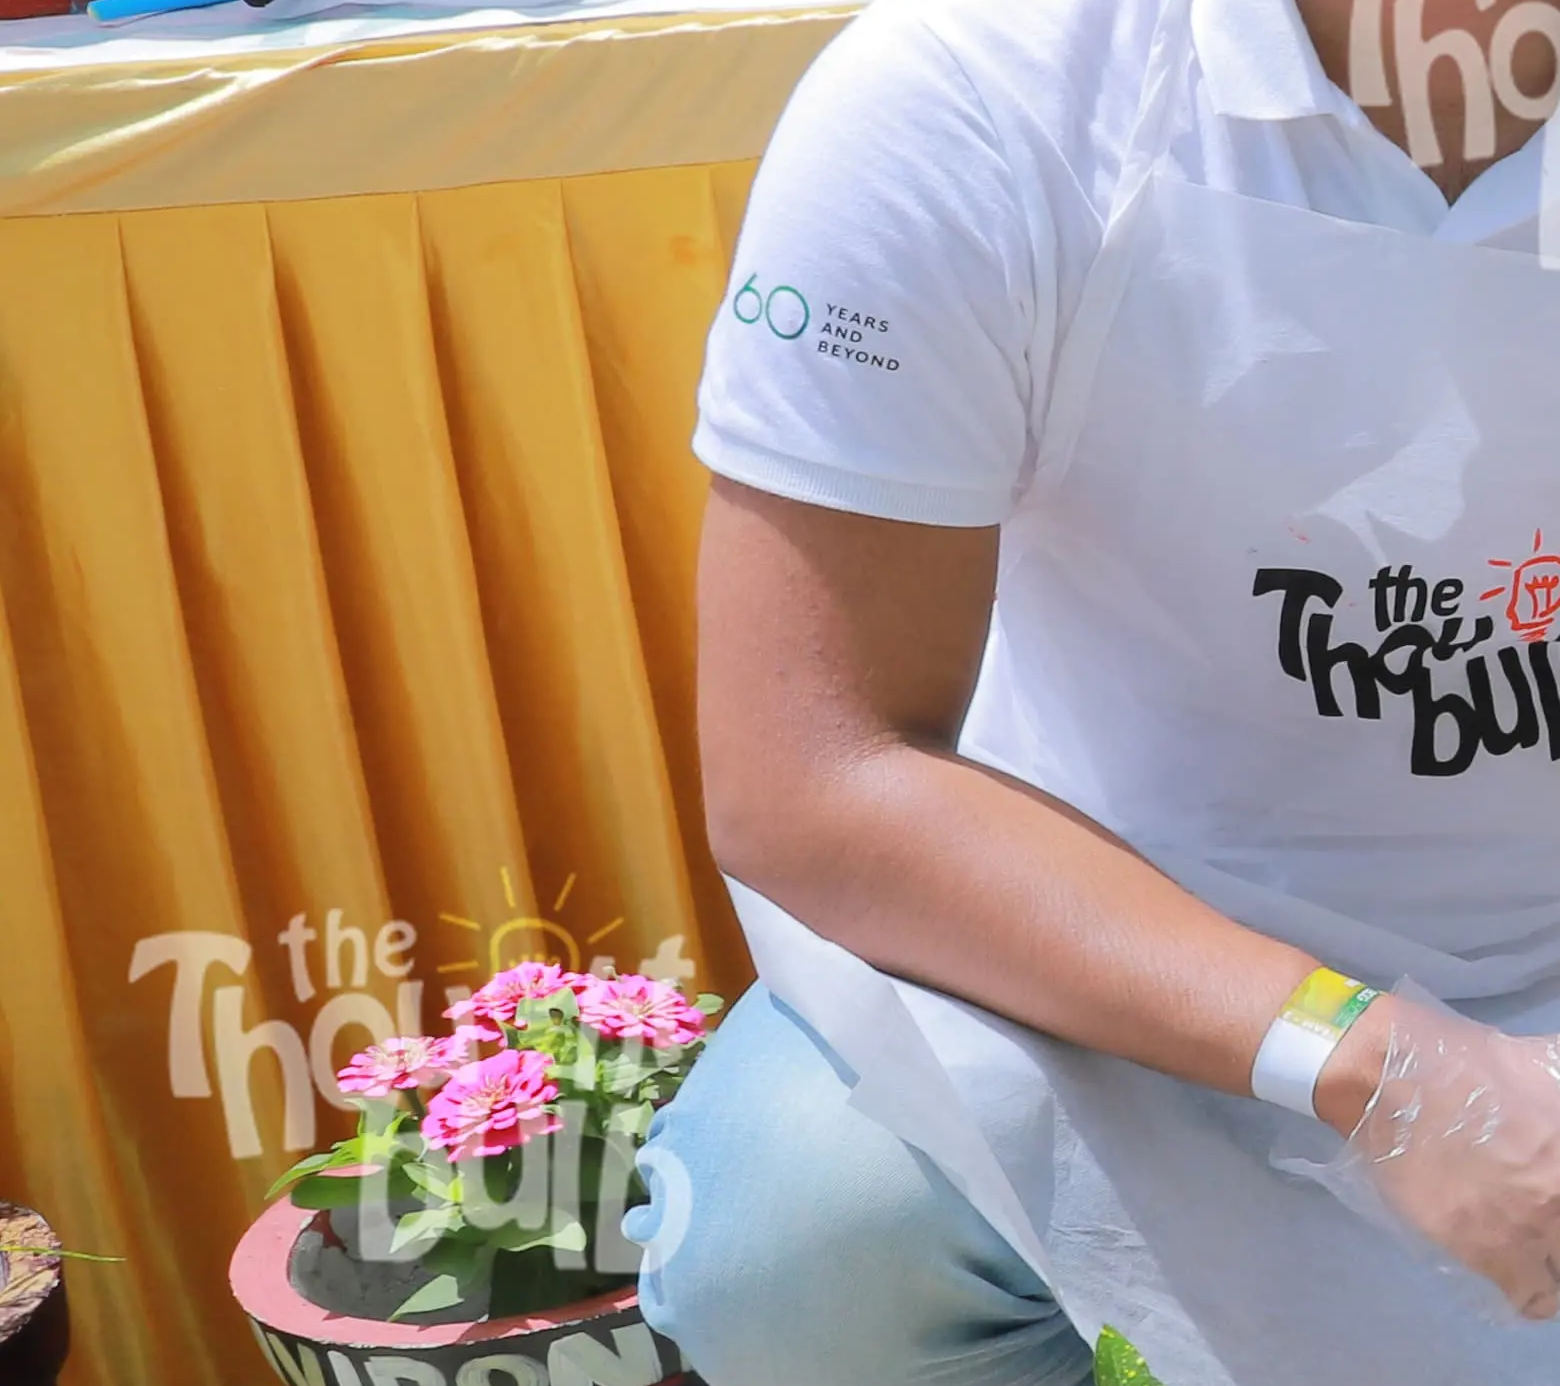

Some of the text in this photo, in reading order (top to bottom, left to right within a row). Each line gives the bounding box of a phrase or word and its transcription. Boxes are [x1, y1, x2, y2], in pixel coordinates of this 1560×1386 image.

[733, 272, 811, 341] 60
[826, 303, 890, 333] YEARS
[821, 322, 863, 343] AND
[817, 340, 901, 371] BEYOND
[1369, 564, 1464, 632] the
